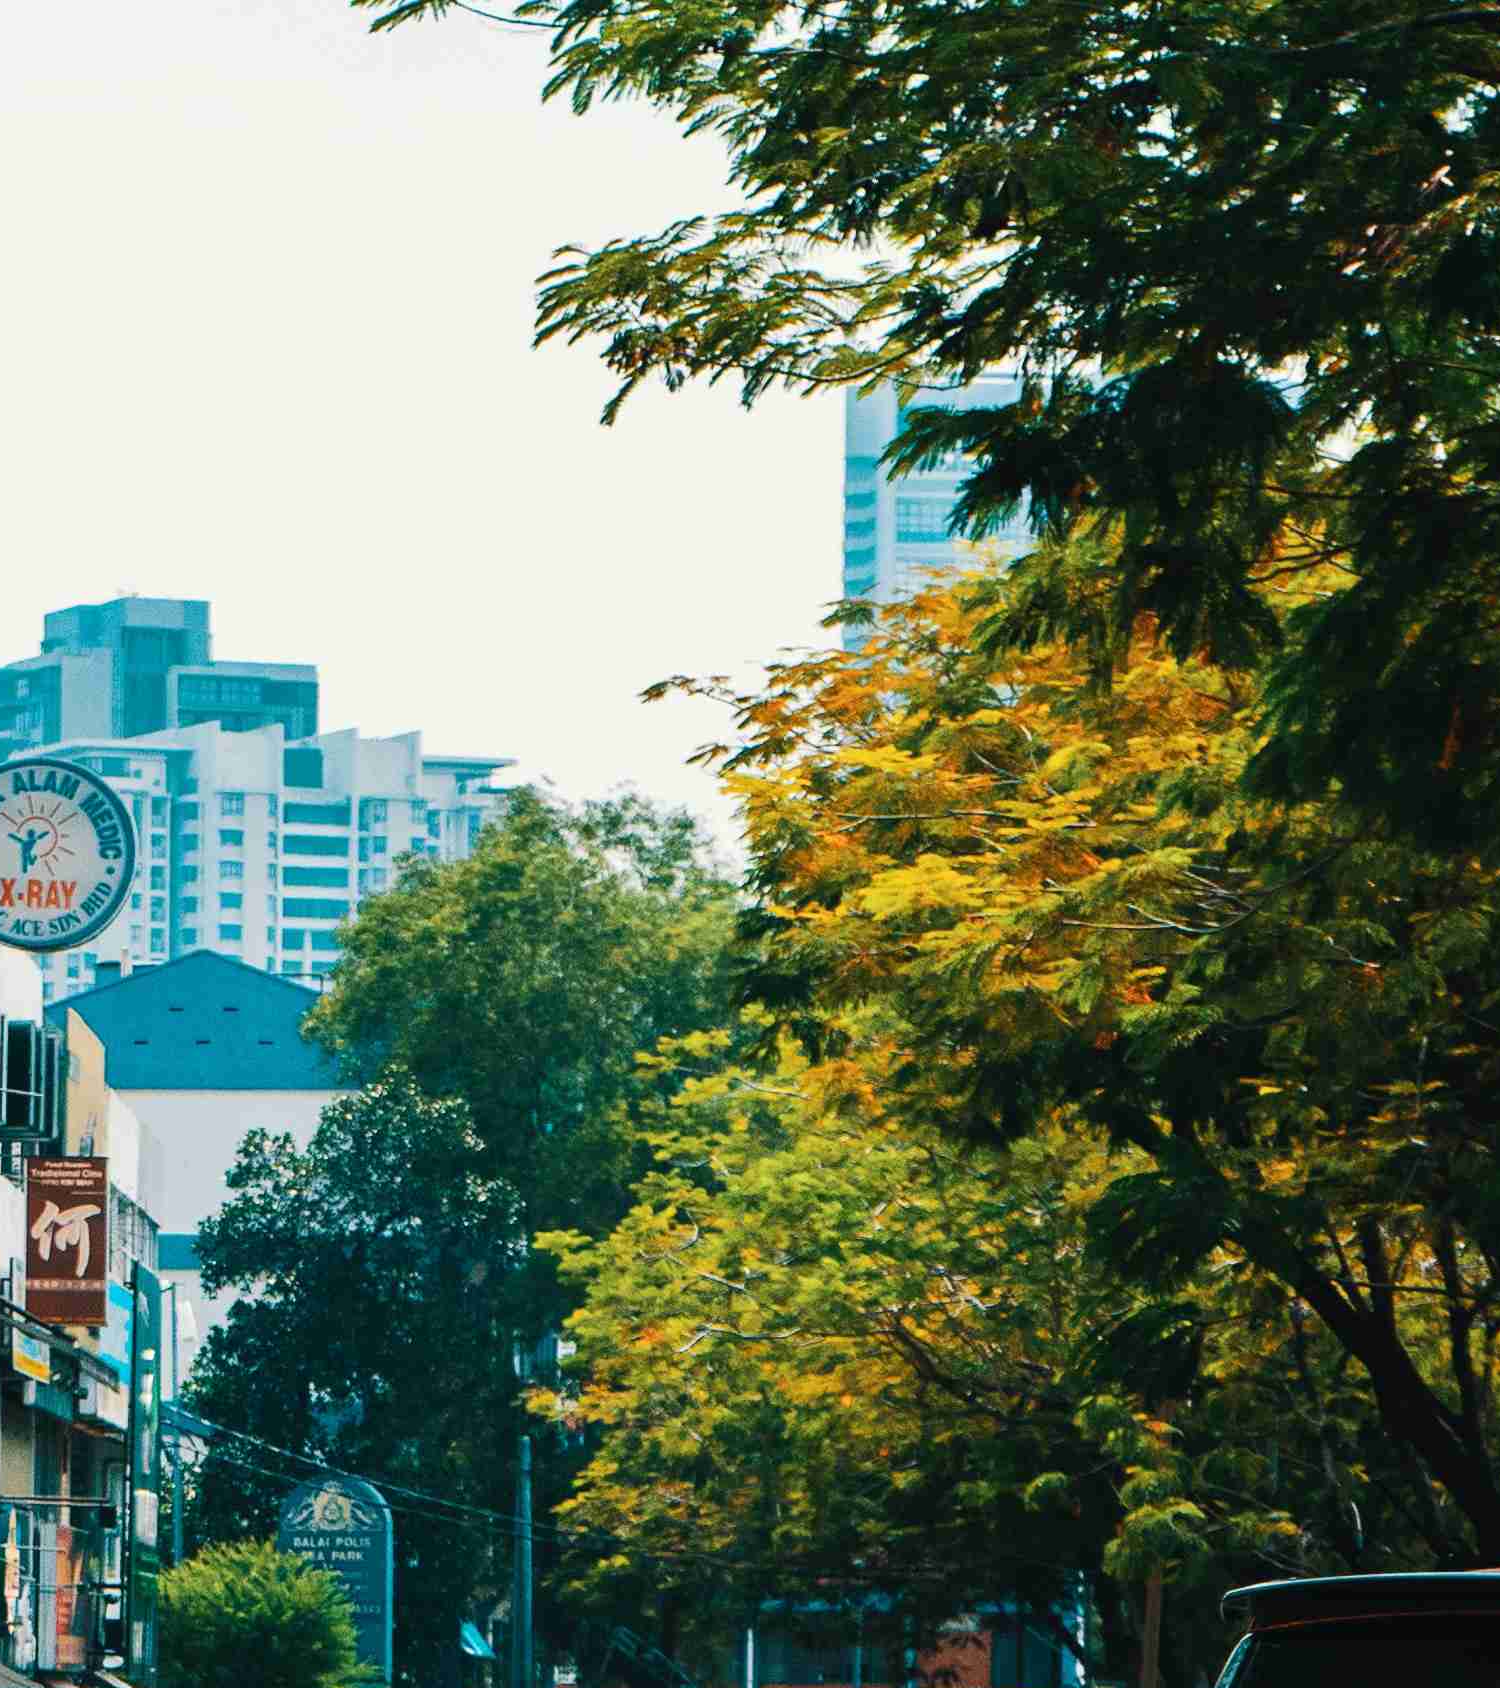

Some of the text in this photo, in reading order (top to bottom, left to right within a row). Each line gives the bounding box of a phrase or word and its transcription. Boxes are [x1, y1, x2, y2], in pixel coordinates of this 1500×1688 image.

[12, 770, 81, 800] ALAM
[78, 791, 122, 860] MEDIC
[9, 918, 45, 937] ACE
[49, 909, 82, 935] SDN
[80, 881, 112, 917] BHD
